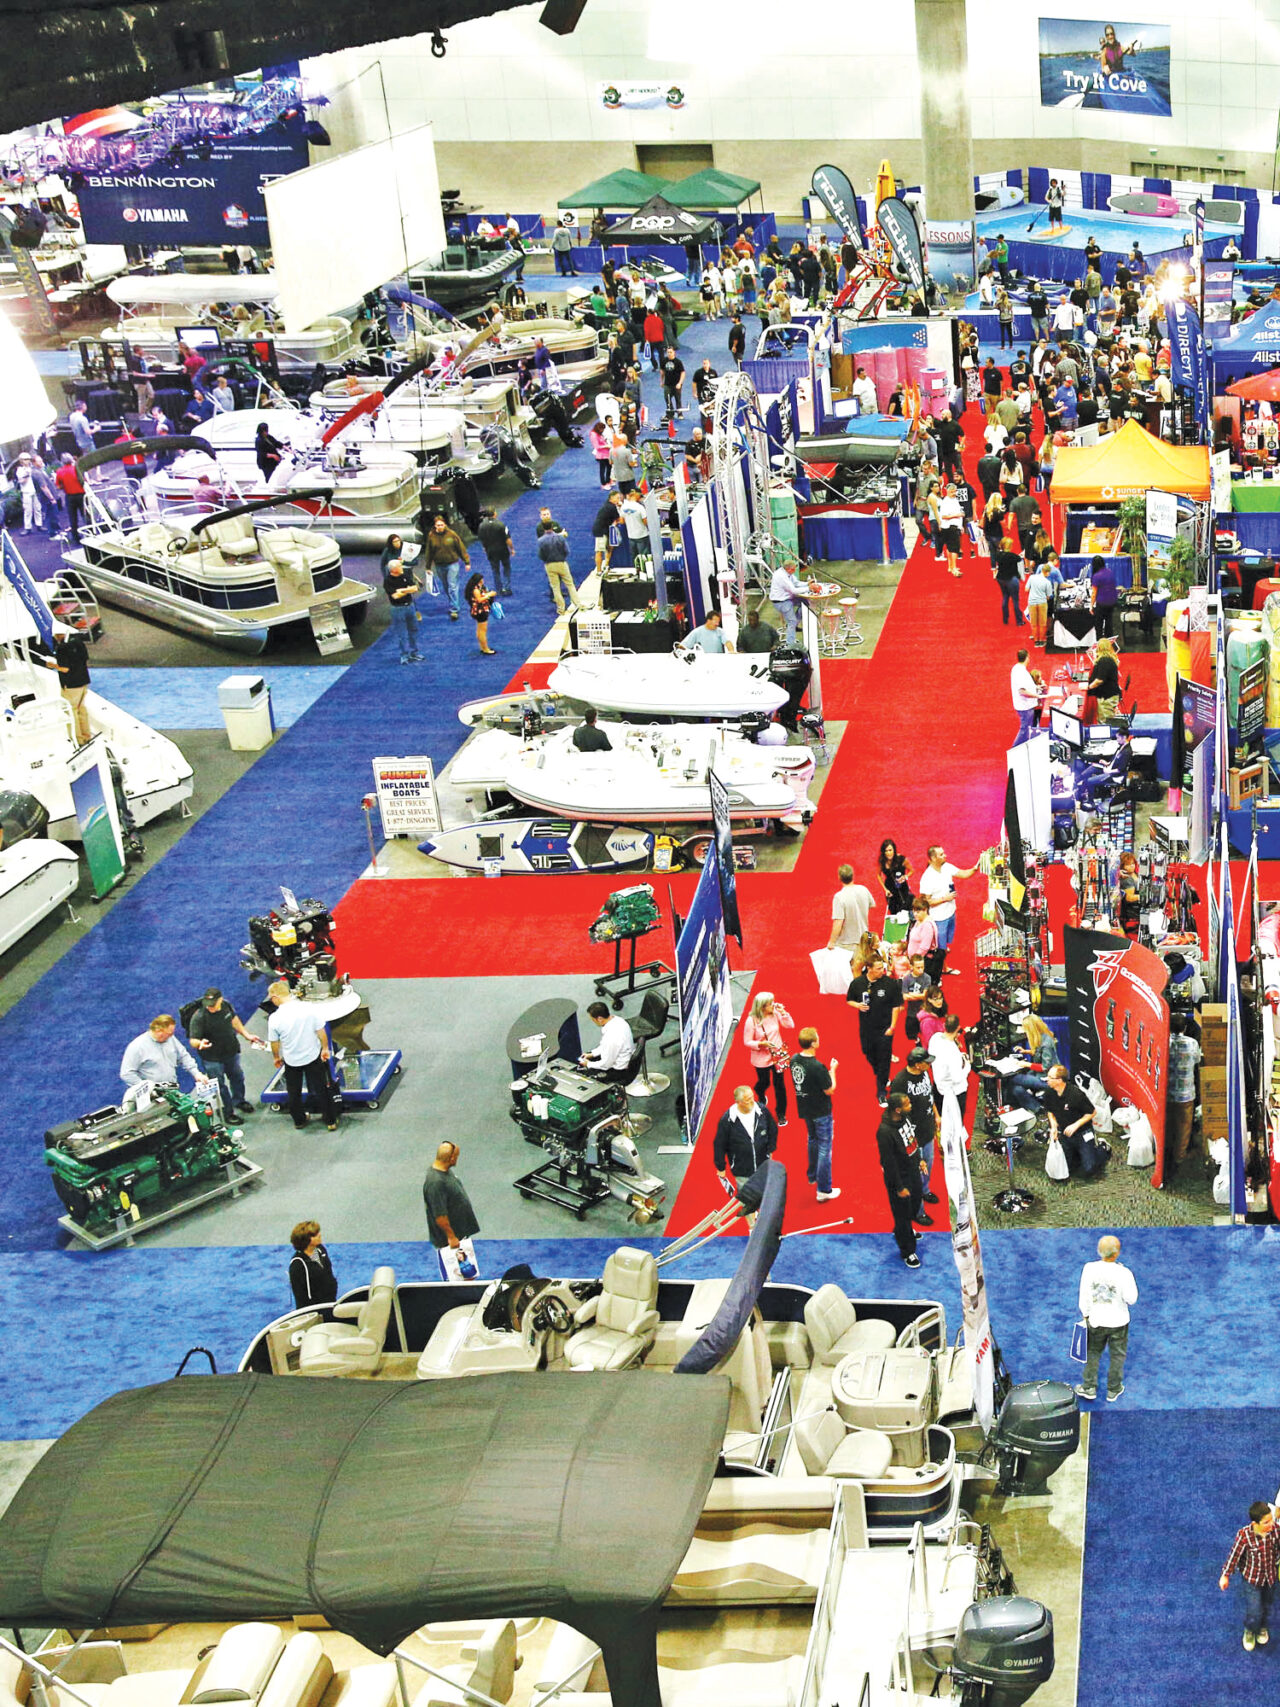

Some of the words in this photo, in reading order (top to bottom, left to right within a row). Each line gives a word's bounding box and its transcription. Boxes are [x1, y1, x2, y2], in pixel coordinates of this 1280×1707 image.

[1062, 69, 1089, 92] Try
[1093, 72, 1105, 90] It
[1108, 73, 1147, 93] Cove
[89, 176, 216, 189] BENNINGTON
[138, 208, 189, 223] YAMAHA
[927, 230, 971, 243] ESSONS
[1177, 323, 1193, 381] DIRECTV
[380, 770, 428, 780] SUNSET
[393, 789, 421, 797] BOATS
[976, 1332, 991, 1364] YAM
[1048, 1428, 1074, 1439] YAMAHA
[1013, 1656, 1043, 1667] YAMAHA
